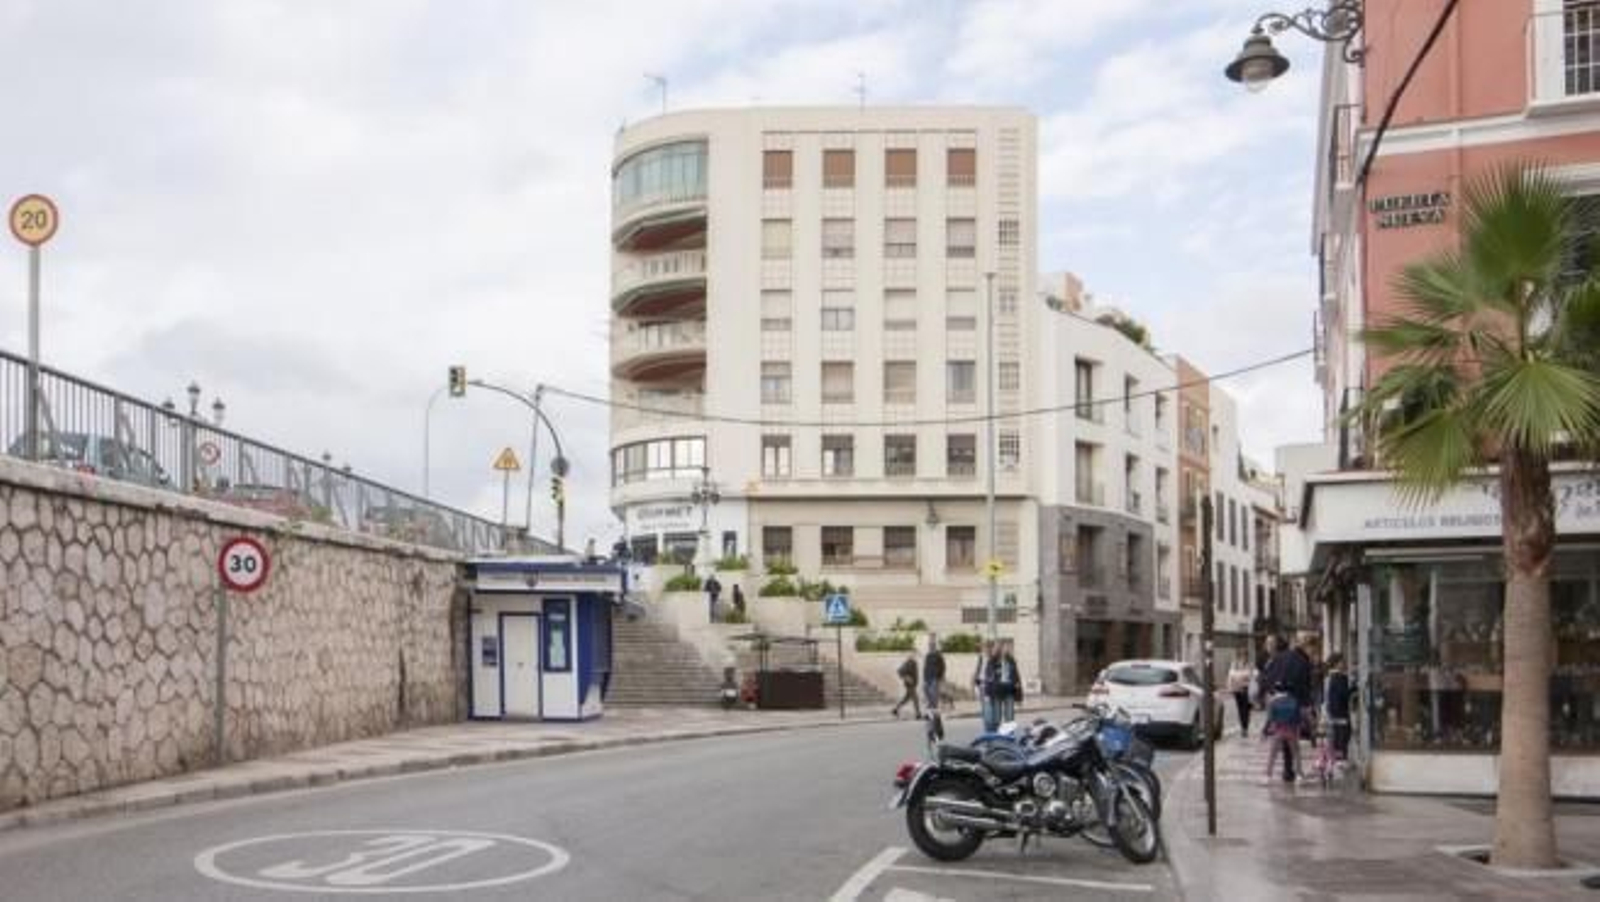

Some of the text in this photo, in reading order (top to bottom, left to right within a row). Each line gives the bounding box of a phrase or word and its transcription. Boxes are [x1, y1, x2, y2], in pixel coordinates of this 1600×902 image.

[20, 209, 47, 230] 20
[1440, 513, 1501, 527] RELIGIOS
[229, 554, 257, 573] 30
[256, 834, 497, 885] 30
